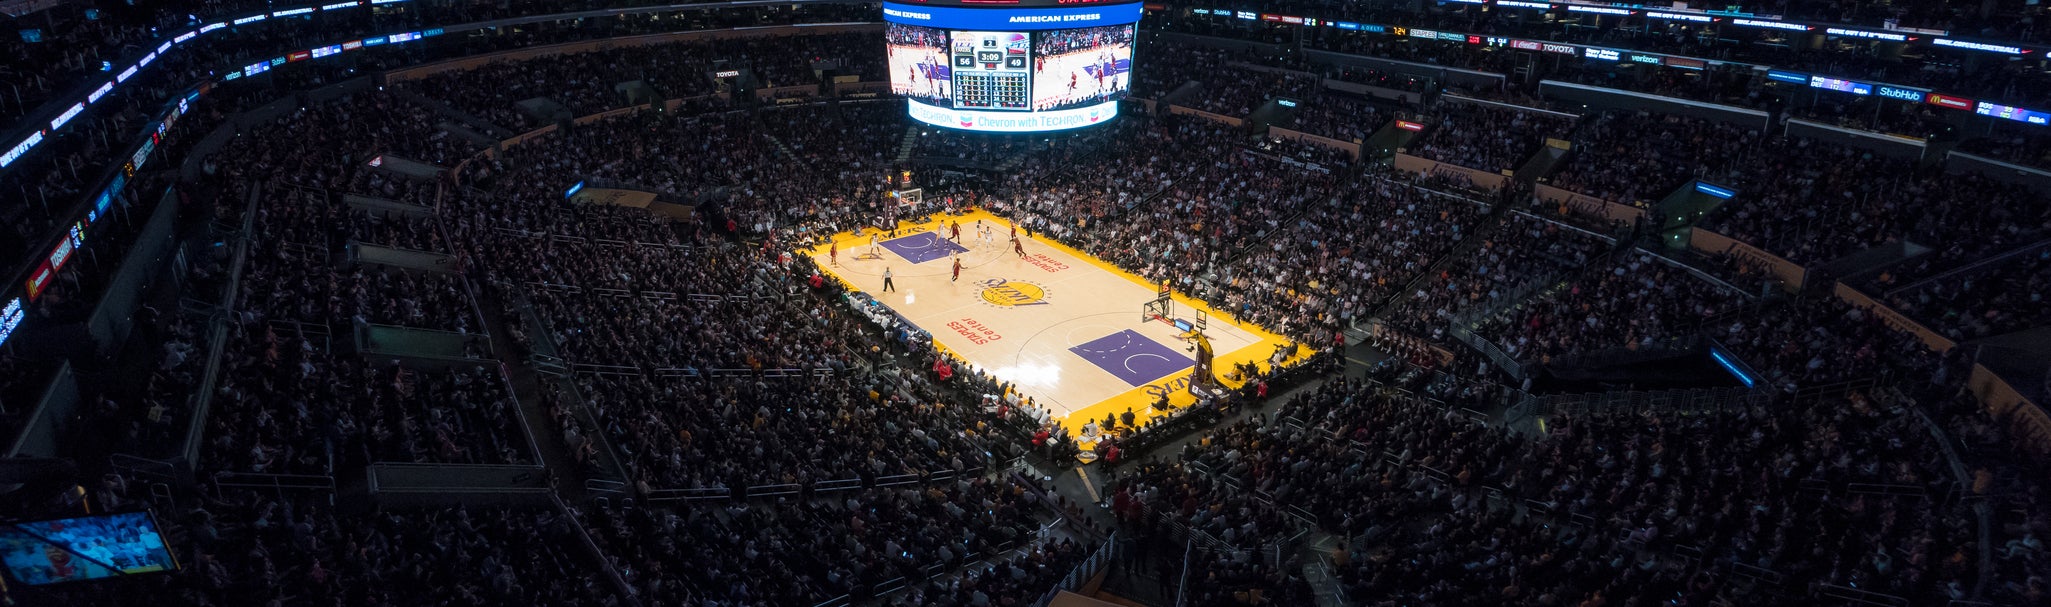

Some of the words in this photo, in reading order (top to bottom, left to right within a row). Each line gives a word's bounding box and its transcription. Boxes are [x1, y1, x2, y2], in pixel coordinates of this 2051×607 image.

[1411, 29, 1436, 38] STAPLES
[1543, 44, 1575, 54] TOYOTA
[1632, 55, 1658, 63] verizon
[1880, 87, 1920, 100] StubHub
[978, 116, 1020, 127] Chevron
[1023, 115, 1037, 127] with
[1033, 253, 1070, 270] Center
[946, 321, 988, 345] STAPLES
[961, 318, 1002, 341] Center
